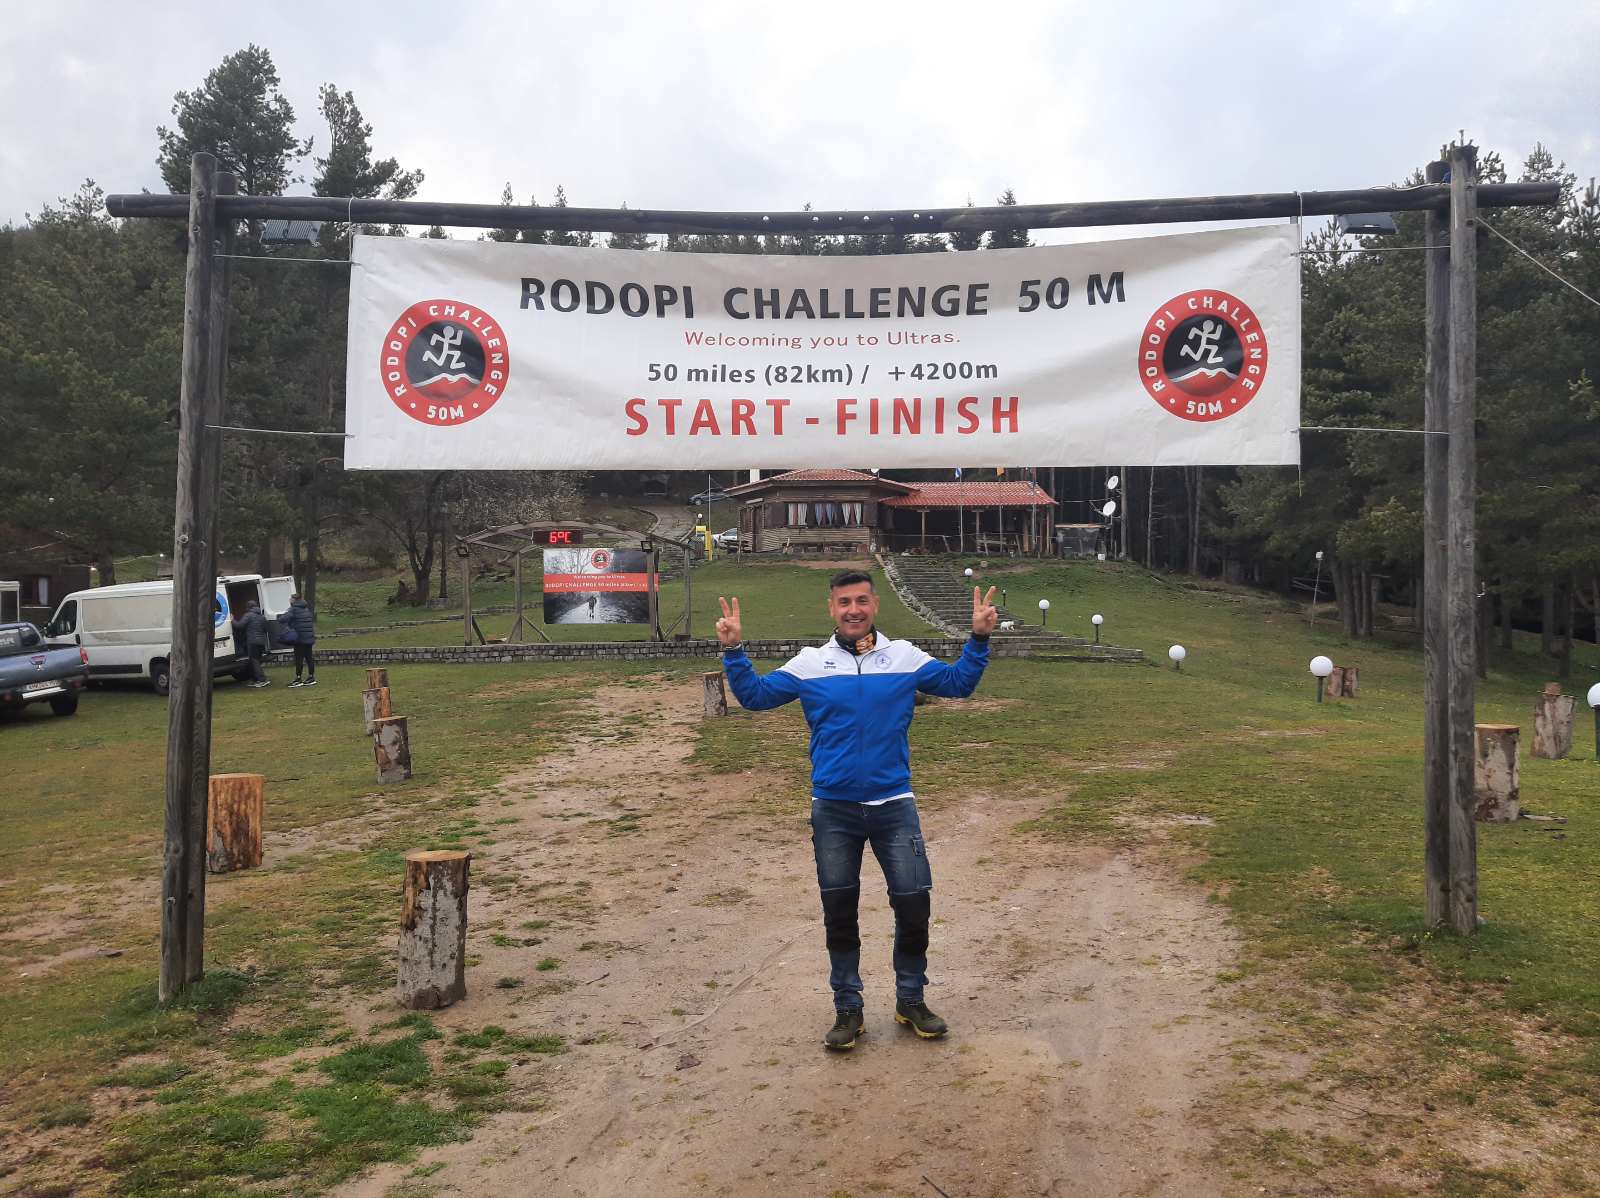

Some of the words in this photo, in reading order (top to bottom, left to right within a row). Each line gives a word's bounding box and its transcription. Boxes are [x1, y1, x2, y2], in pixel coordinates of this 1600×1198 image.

[520, 278, 693, 318] RODOPI
[724, 283, 989, 319] CHALLENGE
[1019, 277, 1071, 312] 50
[1084, 268, 1126, 305] M
[386, 317, 418, 398] RODOPI
[428, 304, 504, 396] CHALLENGE
[685, 332, 802, 349] Welcoming
[810, 337, 848, 349] you
[857, 333, 879, 346] to
[888, 331, 960, 345] Ultras.
[1144, 309, 1176, 393] RODOPI
[1187, 295, 1262, 391] CHALLENGE
[648, 364, 677, 381] 50
[687, 364, 755, 383] miles
[765, 364, 852, 386] (82km)
[861, 365, 869, 384] /
[888, 362, 997, 381] +4200m
[426, 404, 465, 421] 50M
[1185, 399, 1223, 416] 50M
